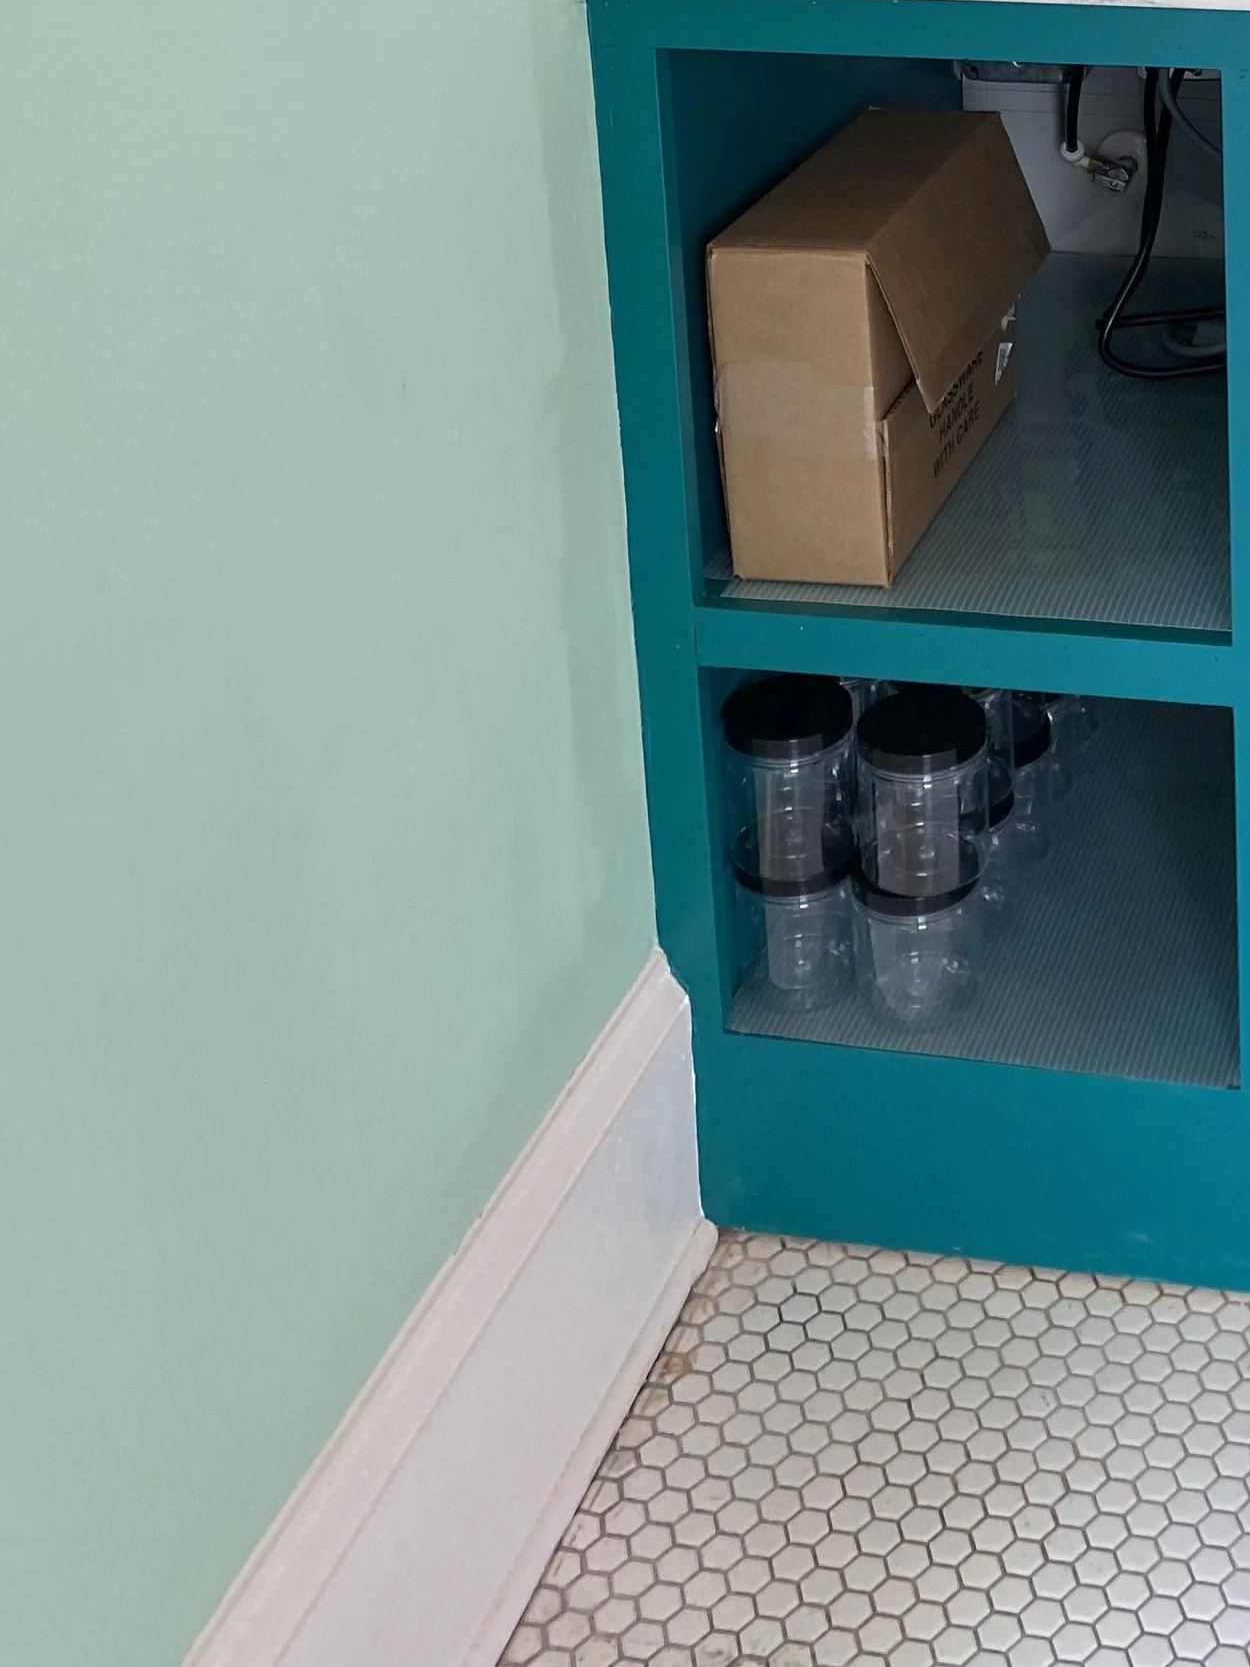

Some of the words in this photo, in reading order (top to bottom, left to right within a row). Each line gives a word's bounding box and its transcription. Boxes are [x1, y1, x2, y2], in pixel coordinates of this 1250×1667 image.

[932, 433, 955, 479] WITH
[956, 398, 982, 447] CARE
[939, 380, 975, 444] HANDLE
